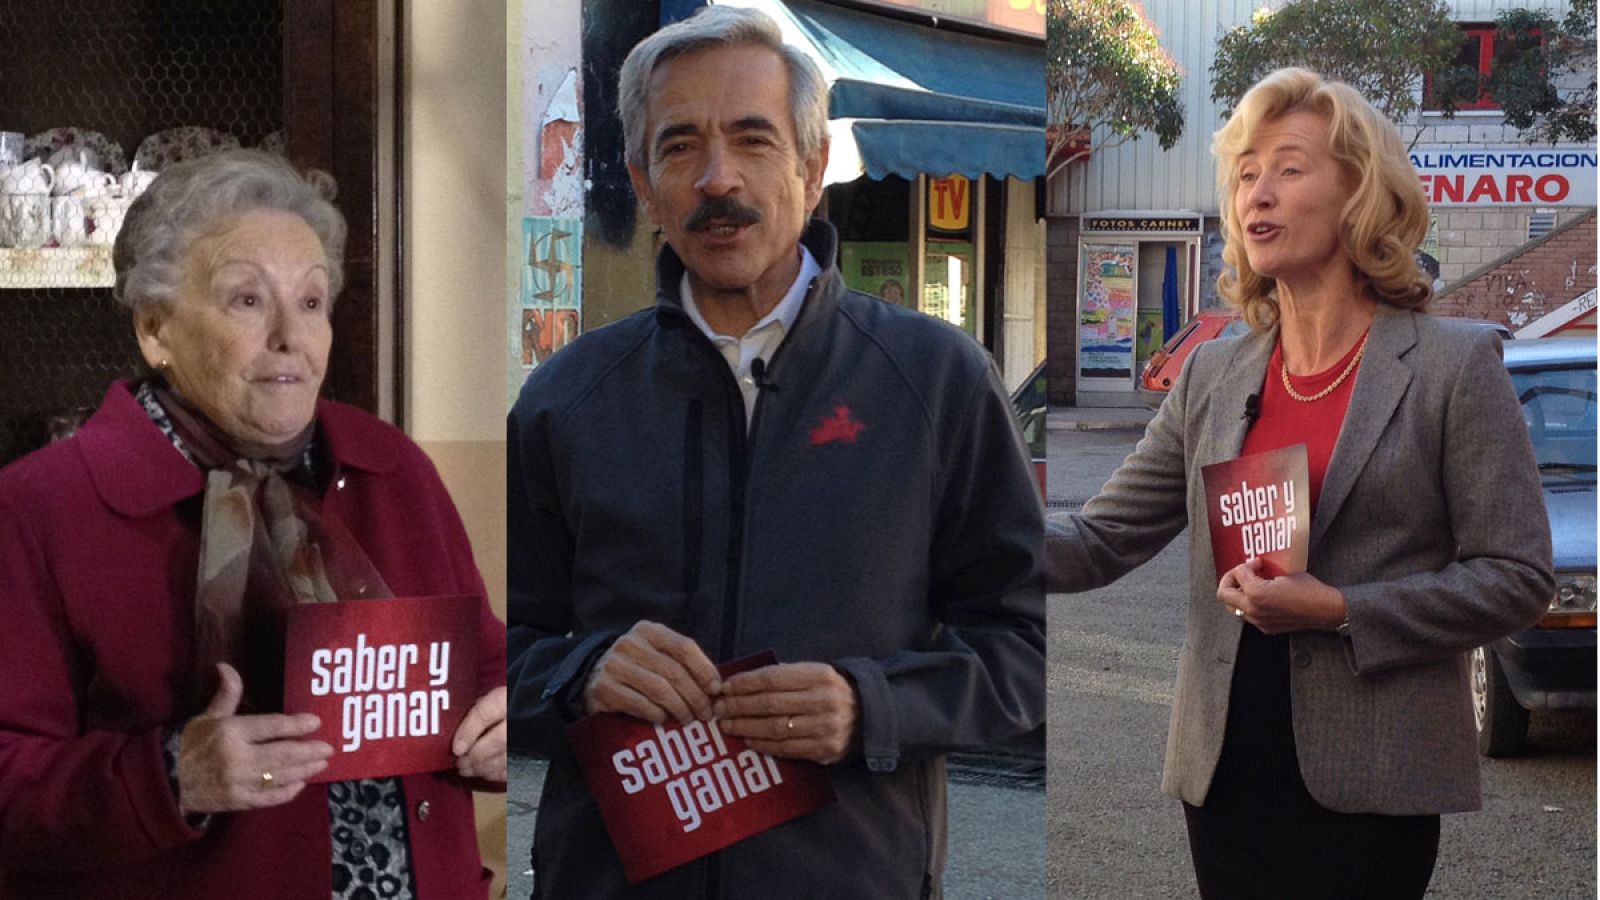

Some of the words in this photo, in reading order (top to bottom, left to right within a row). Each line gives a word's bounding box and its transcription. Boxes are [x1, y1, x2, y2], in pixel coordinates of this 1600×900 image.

[1410, 154, 1597, 168] ALIMENTACION
[934, 178, 966, 220] TV
[1092, 219, 1136, 228] FOTOS
[1140, 219, 1192, 228] CARNET
[1220, 481, 1278, 527] saber
[1283, 480, 1295, 513] y
[1241, 516, 1297, 563] ganar
[310, 633, 418, 696] saber
[429, 641, 450, 686] y
[342, 689, 449, 752] ganar
